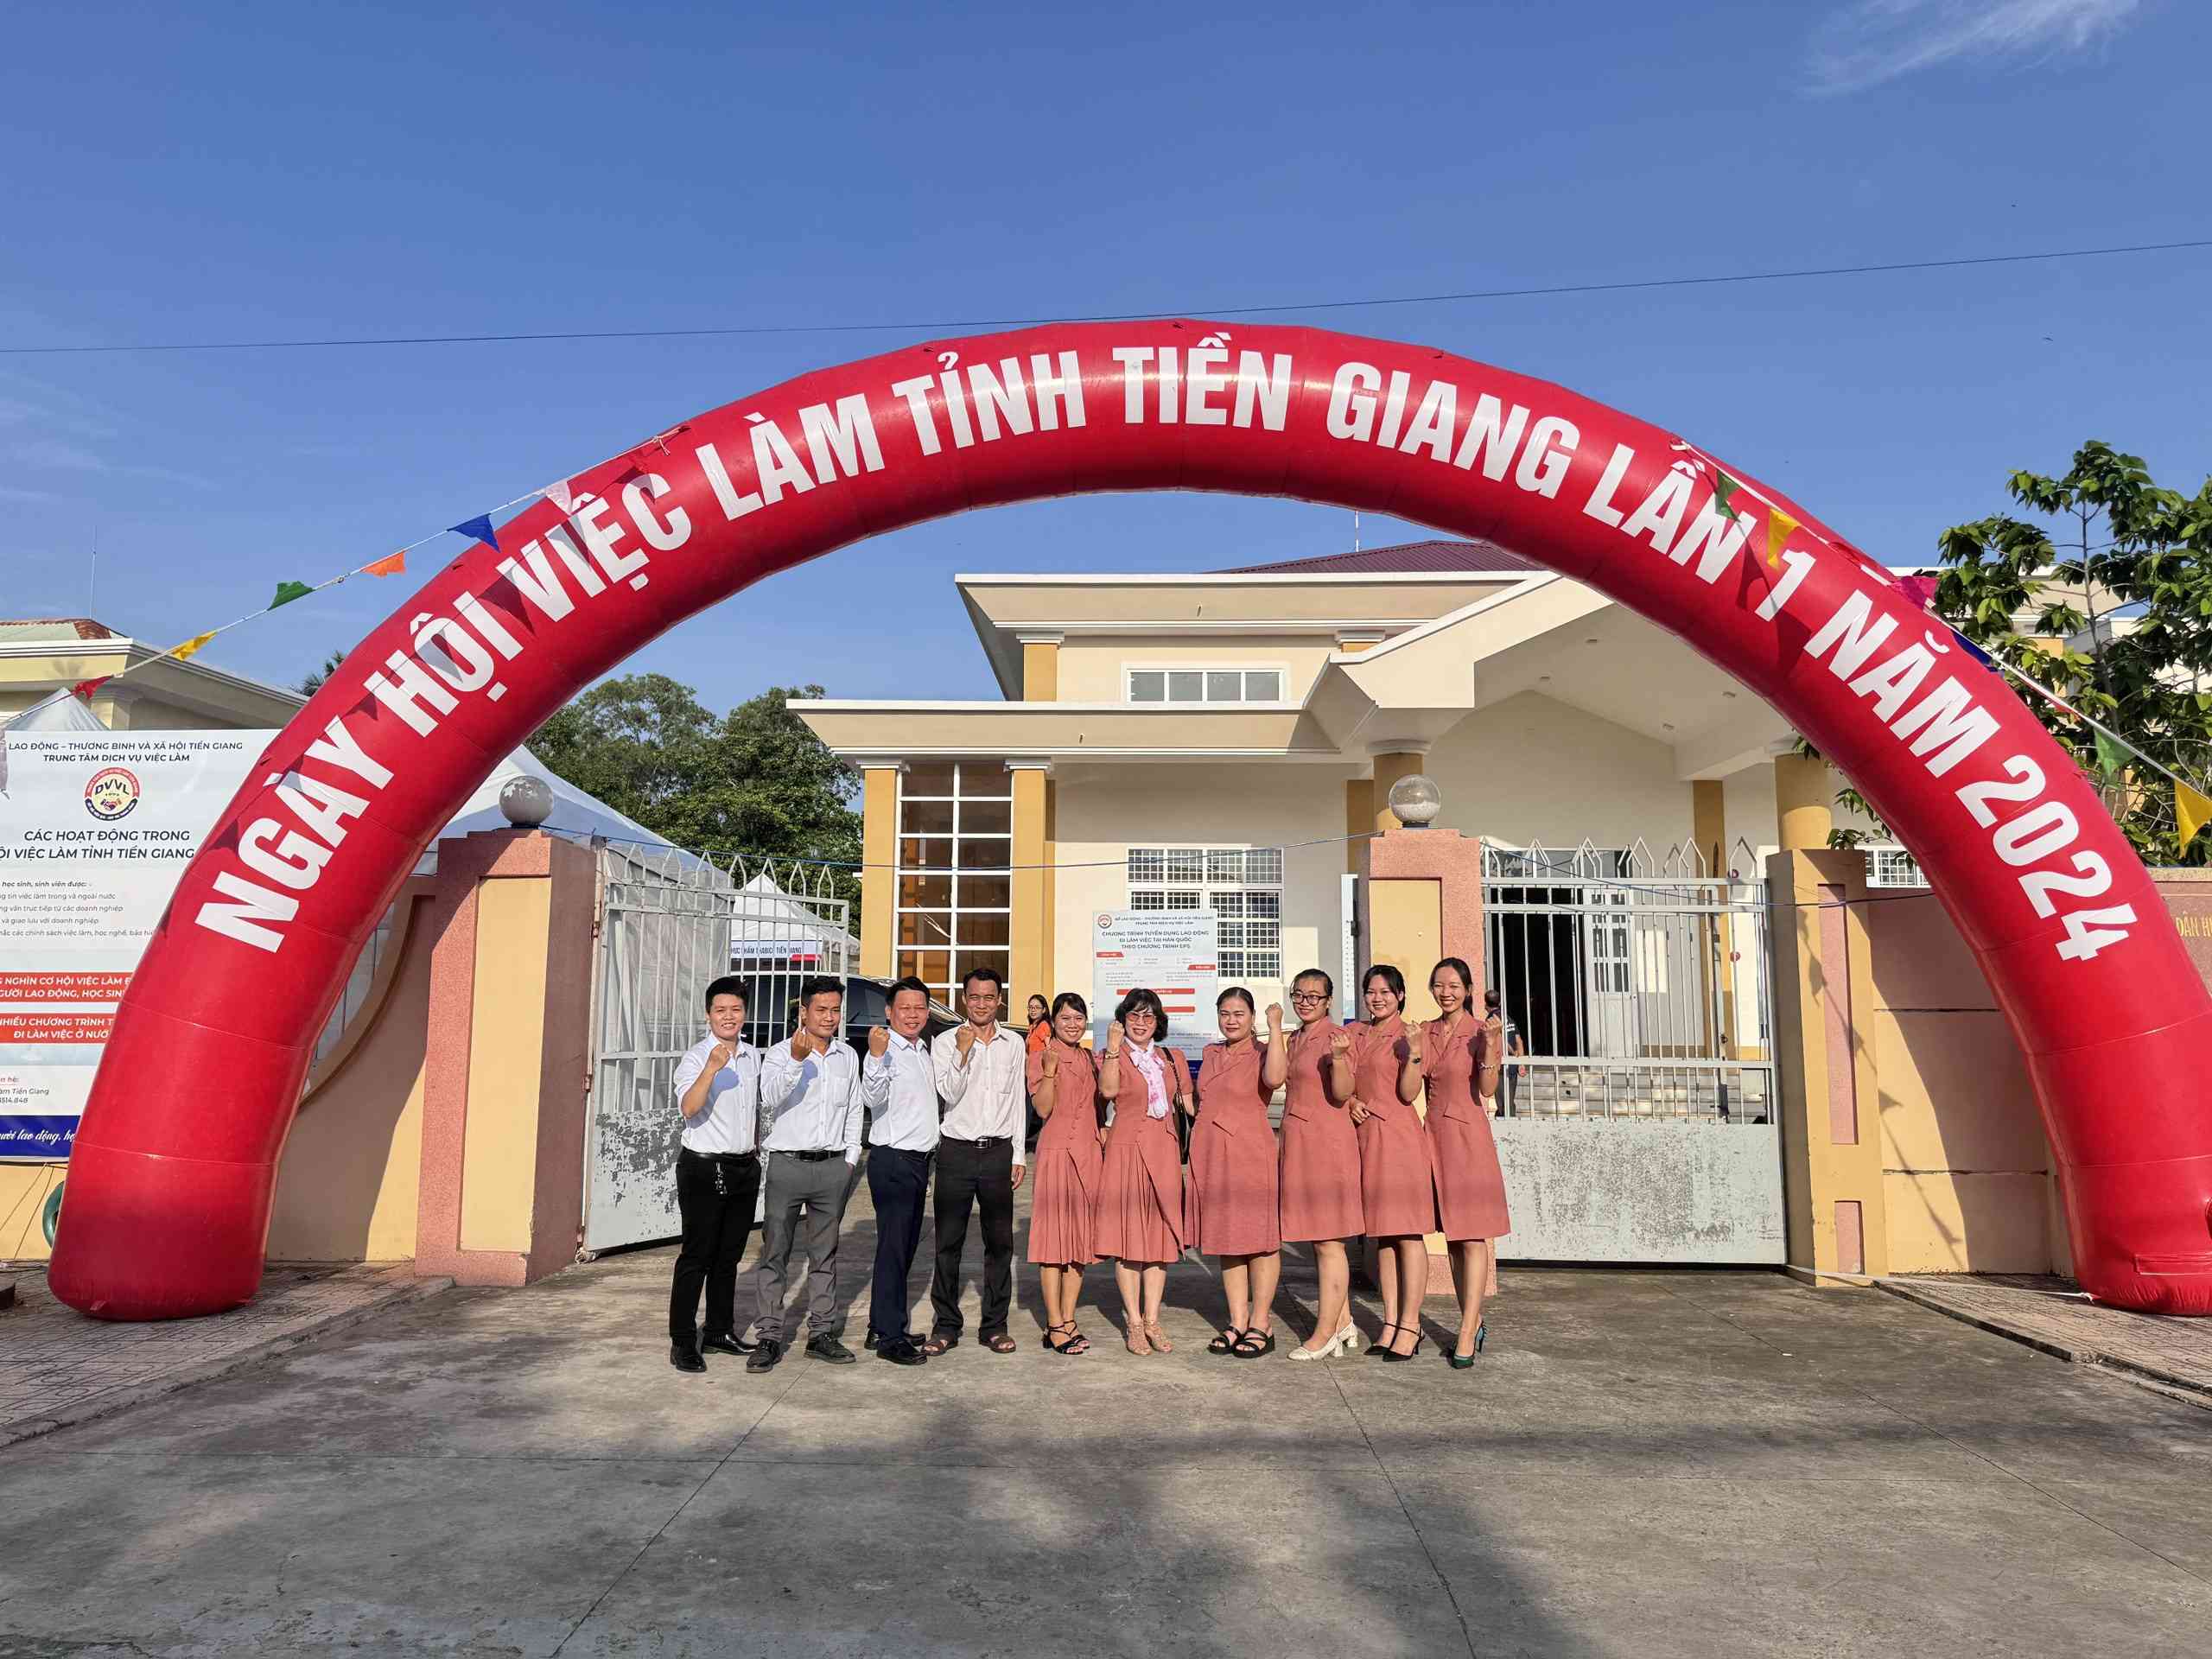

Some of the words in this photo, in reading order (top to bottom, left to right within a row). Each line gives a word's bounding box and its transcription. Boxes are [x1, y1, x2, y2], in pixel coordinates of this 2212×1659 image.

[194, 714, 395, 952] NGÀY
[363, 590, 524, 738] HỘI
[495, 474, 691, 622] VIỆC
[695, 393, 885, 521] LÀM
[891, 351, 1086, 456] TỈNH
[1112, 332, 1293, 431] TIỀN
[1325, 361, 1580, 499] GIANG
[1582, 442, 1758, 584] LẦN
[1754, 549, 1816, 622] 1
[1803, 588, 2001, 778] NĂM
[1955, 754, 2139, 962] 2024
[30, 741, 59, 751] ĐỘNG
[68, 741, 110, 750] THƯƠNG
[138, 741, 151, 750] VÀ
[168, 741, 186, 751] HỘI
[79, 753, 99, 762] TÂM
[101, 754, 125, 763] DỊCH
[145, 753, 167, 763] VIỆC
[168, 753, 190, 761] LÀM
[95, 779, 130, 796] DVVL
[24, 828, 53, 842] CÁC
[56, 830, 95, 844] HOẠT
[97, 828, 139, 844] ĐỘNG
[142, 830, 190, 842] TRONG
[0, 846, 10, 861] ỘI
[14, 846, 46, 861] VIỆC
[48, 845, 78, 859] LÀM
[81, 844, 114, 859] TỈNH
[151, 848, 194, 859] GIANG
[101, 975, 123, 985] LÀM
[25, 989, 45, 998] LAO
[75, 1016, 105, 1027] TRÌNH
[14, 1030, 25, 1039] ĐI
[27, 1028, 48, 1039] LÀM
[17, 1128, 35, 1141] lao
[63, 1128, 76, 1142] họ
